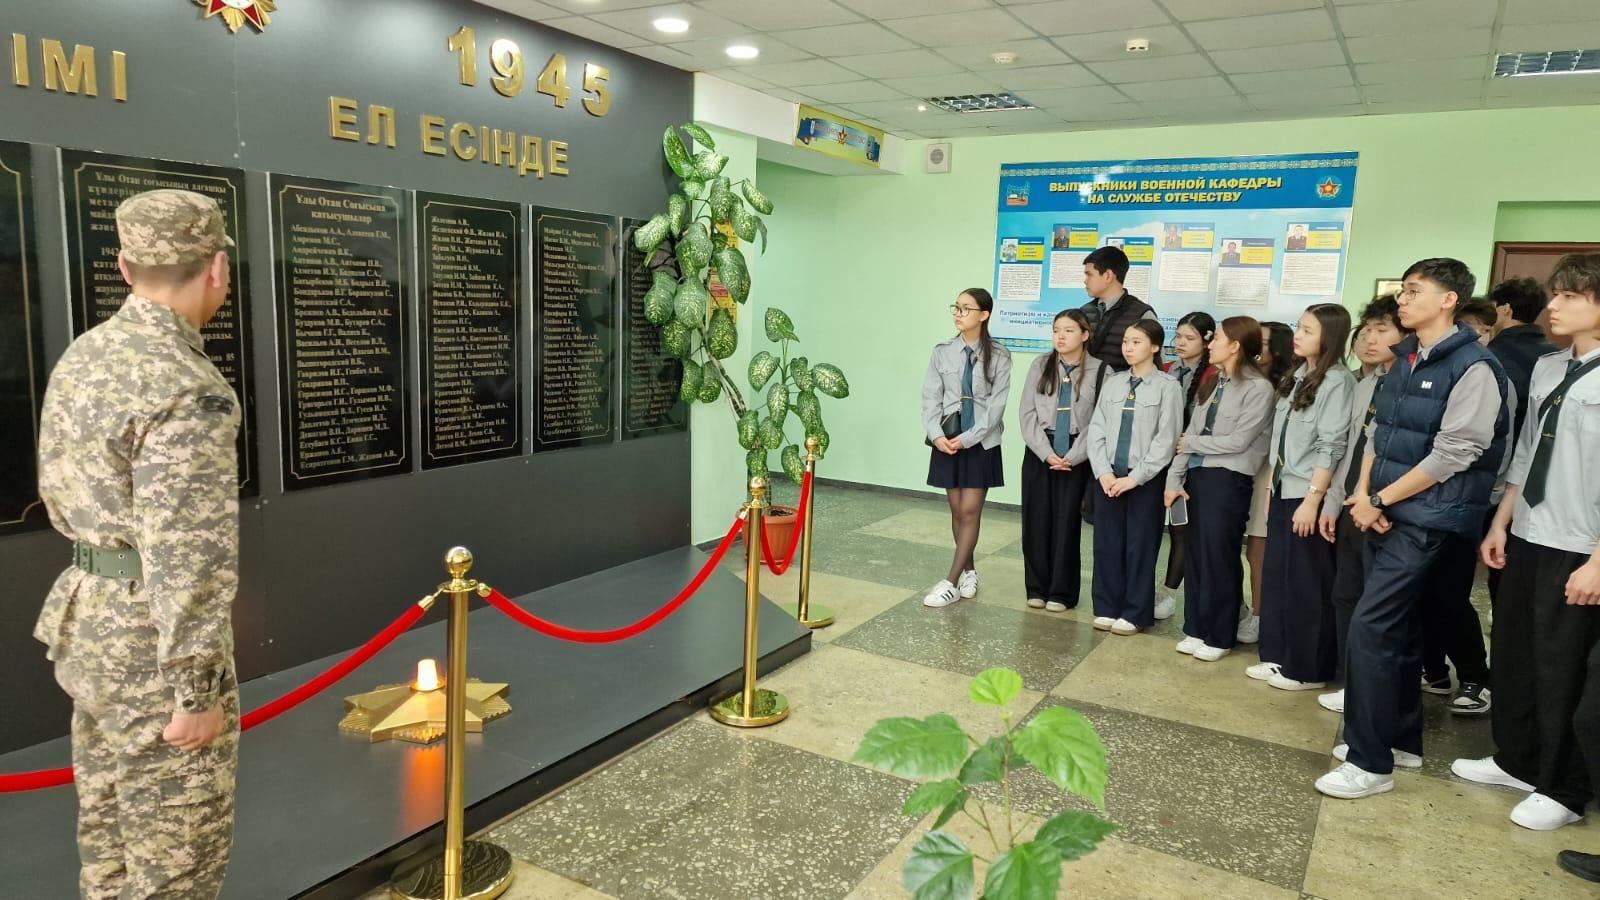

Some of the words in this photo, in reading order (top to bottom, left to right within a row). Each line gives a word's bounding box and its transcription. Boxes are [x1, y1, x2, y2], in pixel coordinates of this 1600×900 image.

[447, 25, 612, 117] 1945
[329, 96, 396, 148] ЕЛ
[421, 115, 569, 178] ЕСІНДЕ
[1088, 193, 1105, 203] НА
[1108, 193, 1162, 203] СЛУЖБЕ
[1165, 191, 1242, 203] ОТЕЧЕСТВУ
[1141, 176, 1206, 191] ВОЕННОЙ
[1209, 177, 1282, 190] КАФЕДРЫ
